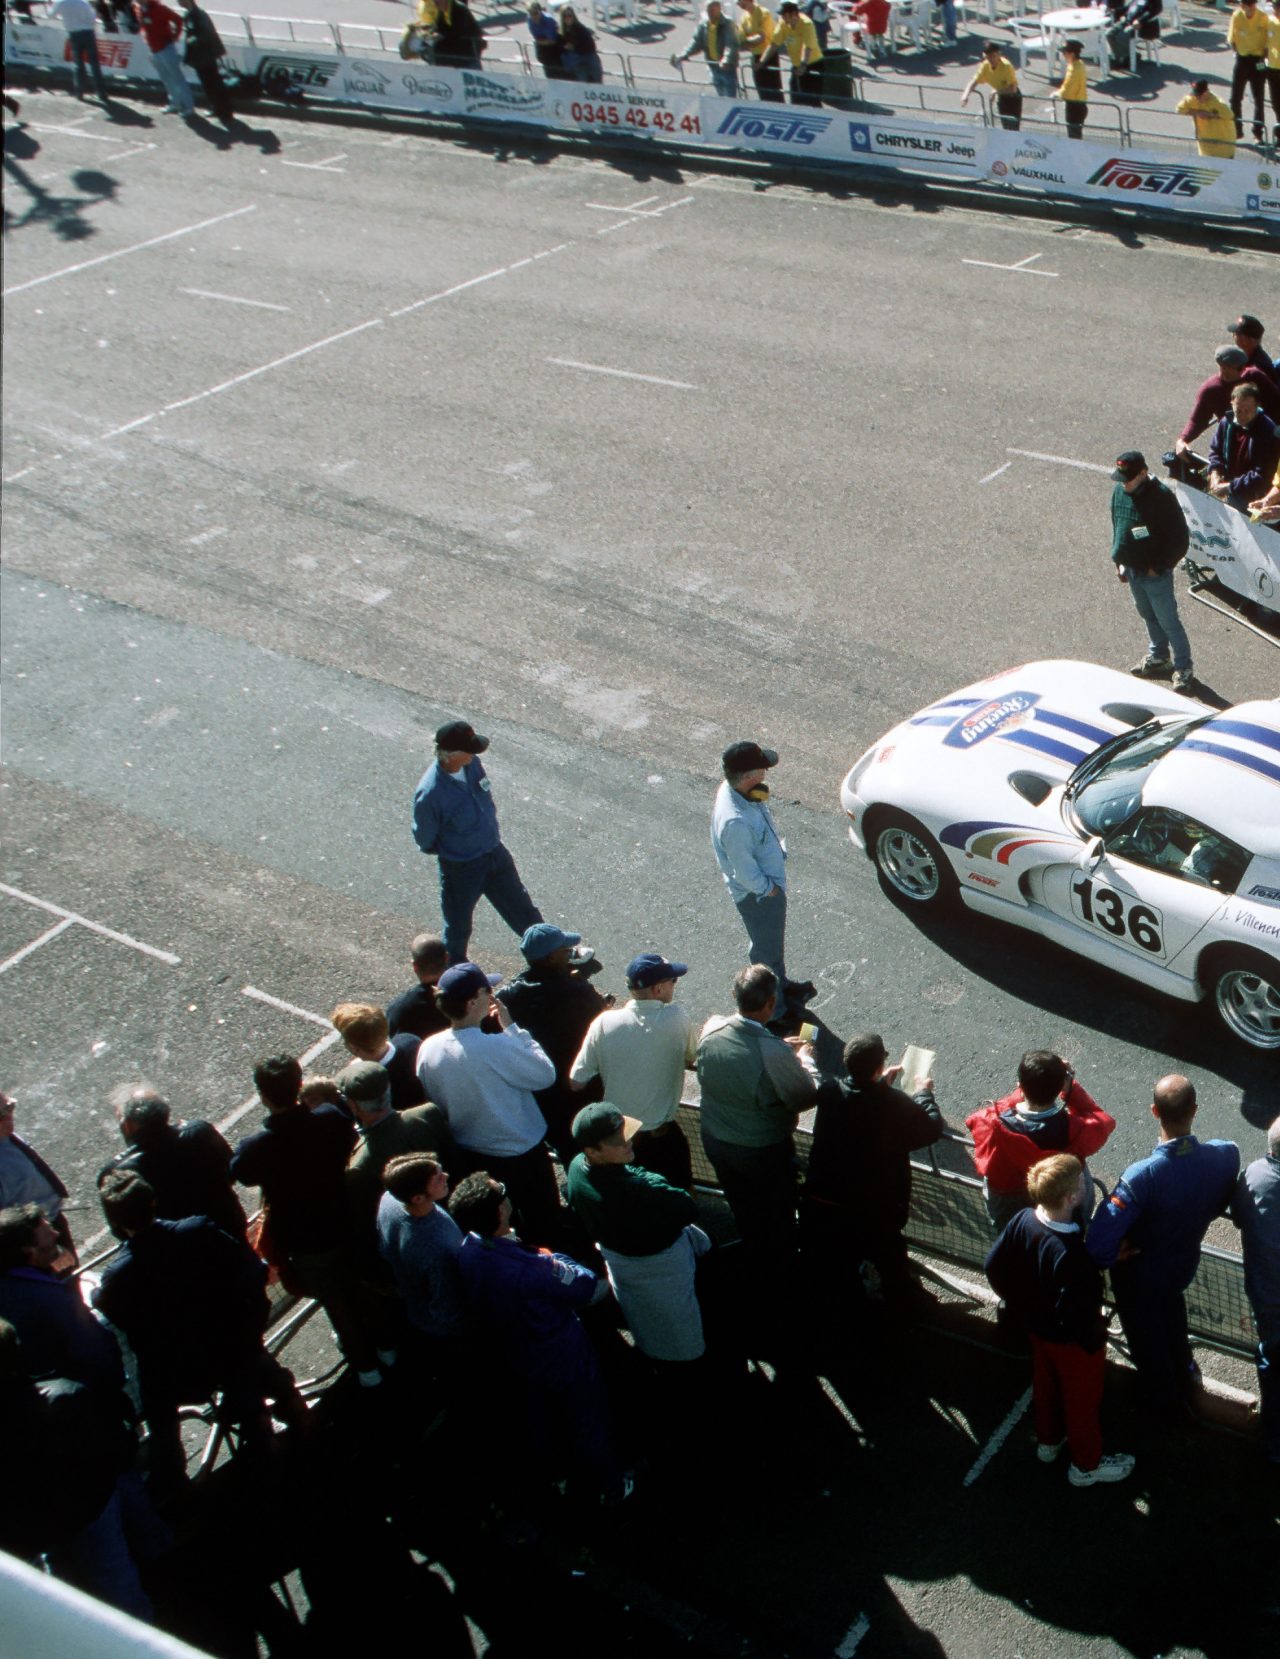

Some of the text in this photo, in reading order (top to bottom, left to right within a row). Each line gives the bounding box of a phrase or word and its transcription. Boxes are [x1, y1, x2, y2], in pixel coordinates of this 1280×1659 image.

[584, 91, 667, 109] LO-CALL SERVICE
[571, 102, 620, 125] 0345
[625, 108, 648, 128] 42
[653, 112, 675, 132] 42
[680, 115, 701, 134] 41
[876, 133, 977, 158] CHRYSLER Jeep
[1015, 148, 1048, 160] JAGUAR
[1012, 167, 1066, 184] VAUXHALL
[1073, 878, 1163, 952] 136
[1219, 906, 1229, 921] J.
